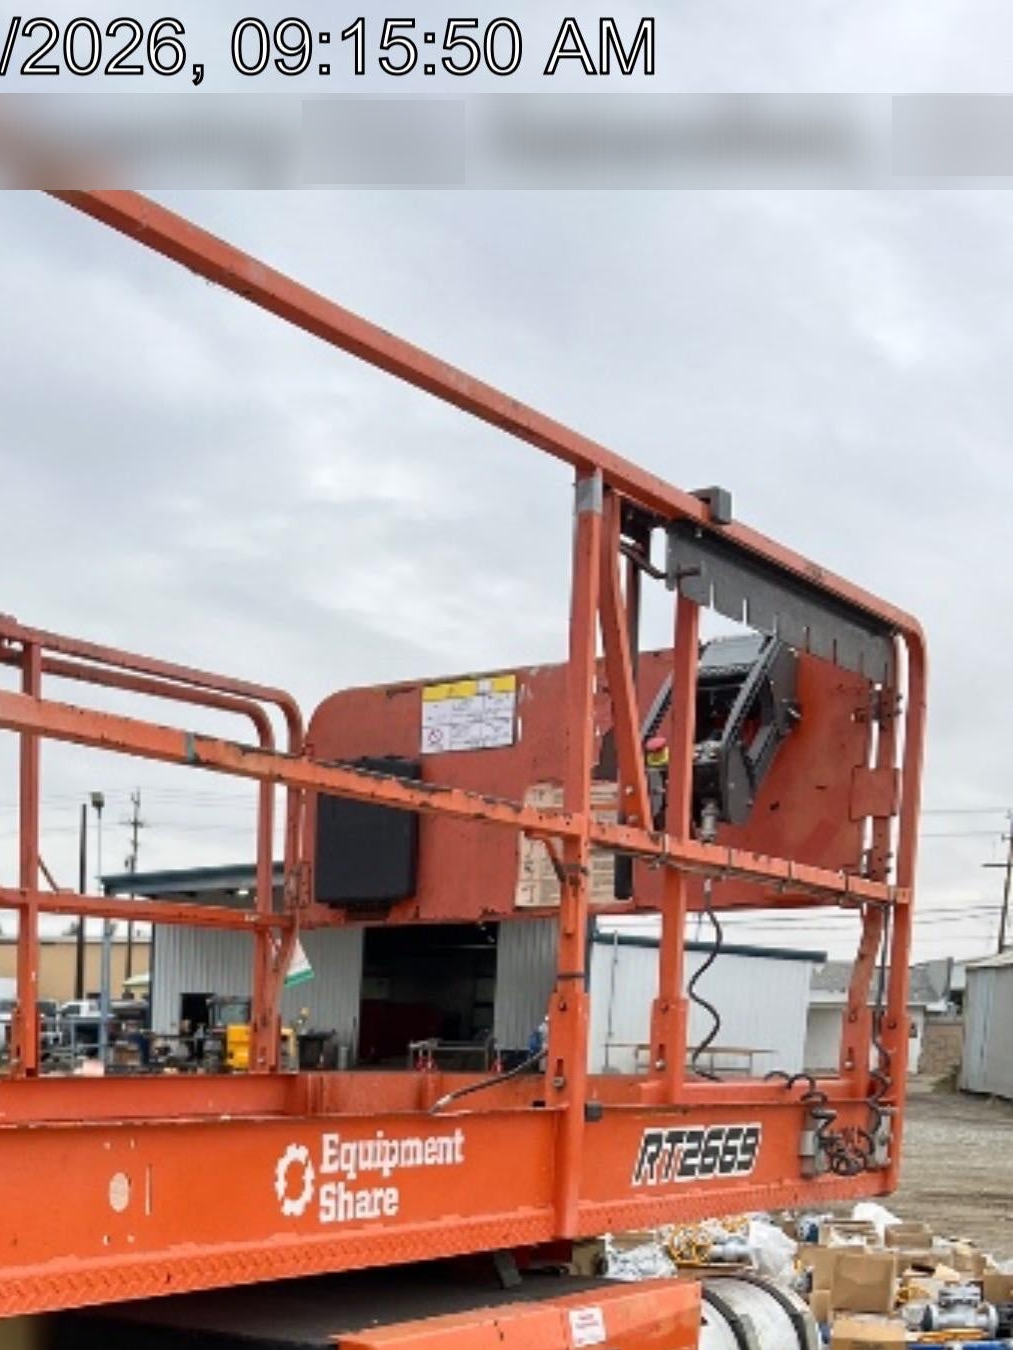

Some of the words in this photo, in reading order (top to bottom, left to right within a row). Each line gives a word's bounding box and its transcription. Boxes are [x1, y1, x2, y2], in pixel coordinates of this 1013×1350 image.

[319, 1128, 465, 1180] Equipment
[631, 1122, 762, 1186] RT2669
[319, 1181, 399, 1223] Share
